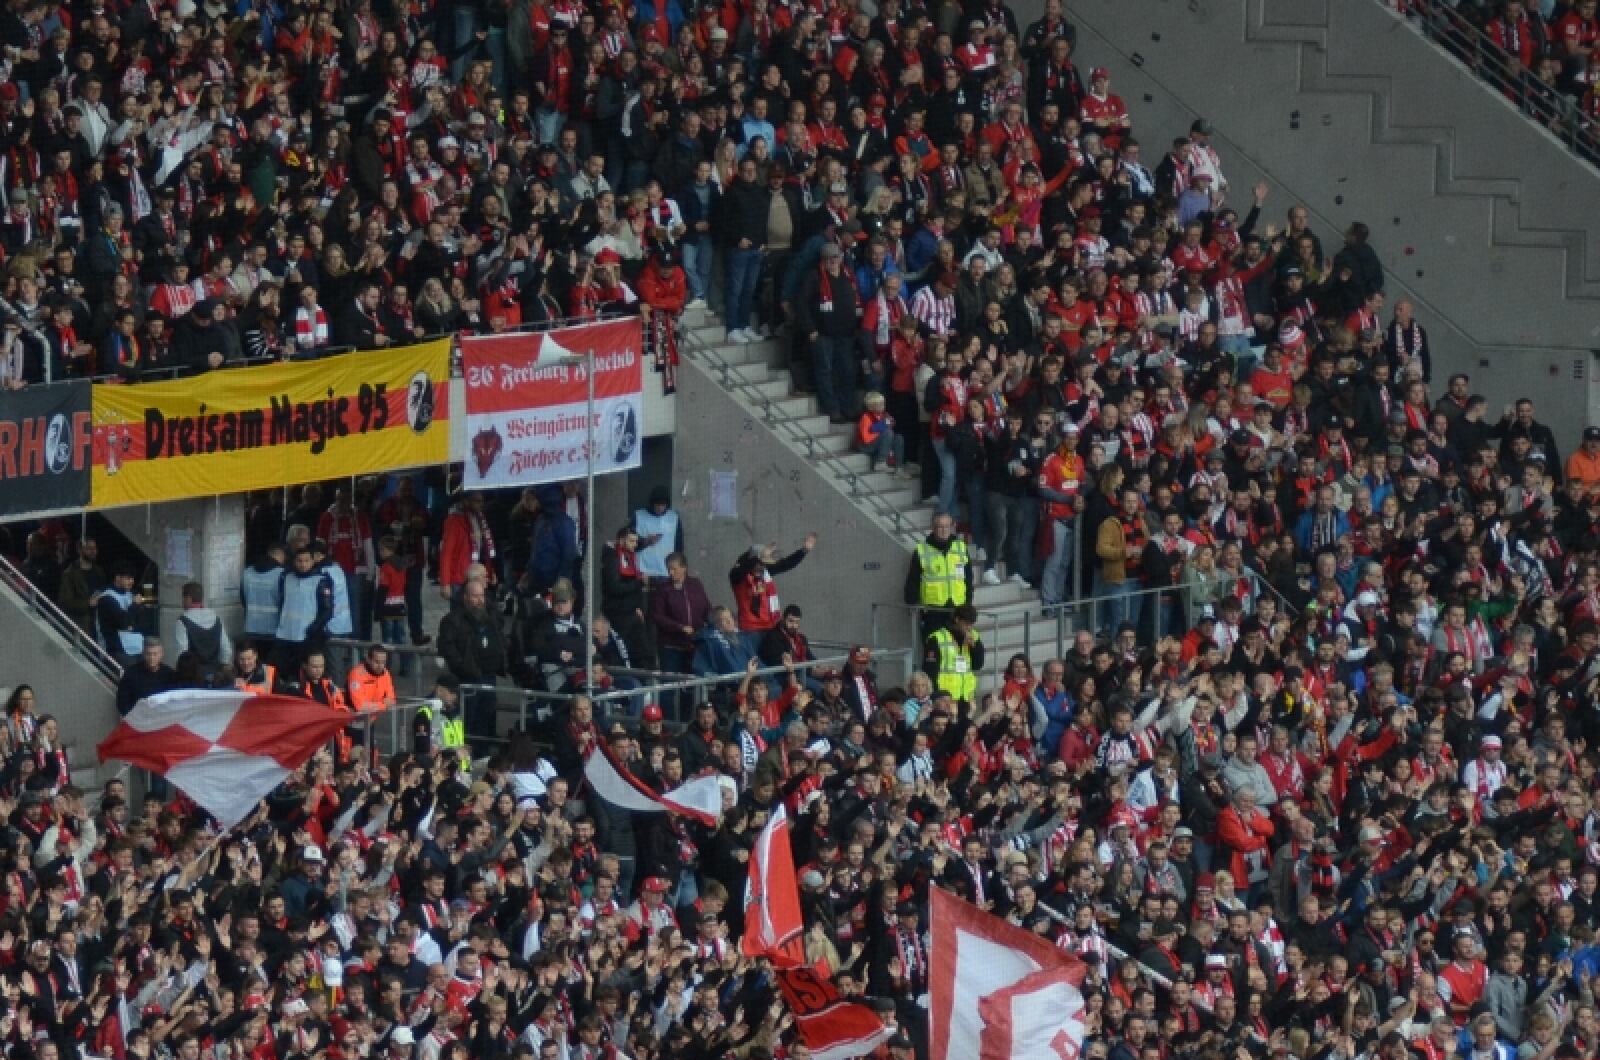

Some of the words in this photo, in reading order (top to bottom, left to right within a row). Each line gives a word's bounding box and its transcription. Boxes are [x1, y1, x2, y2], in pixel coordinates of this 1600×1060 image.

[144, 403, 264, 460] Dreisam
[270, 385, 349, 454] Magic
[358, 382, 389, 433] 95
